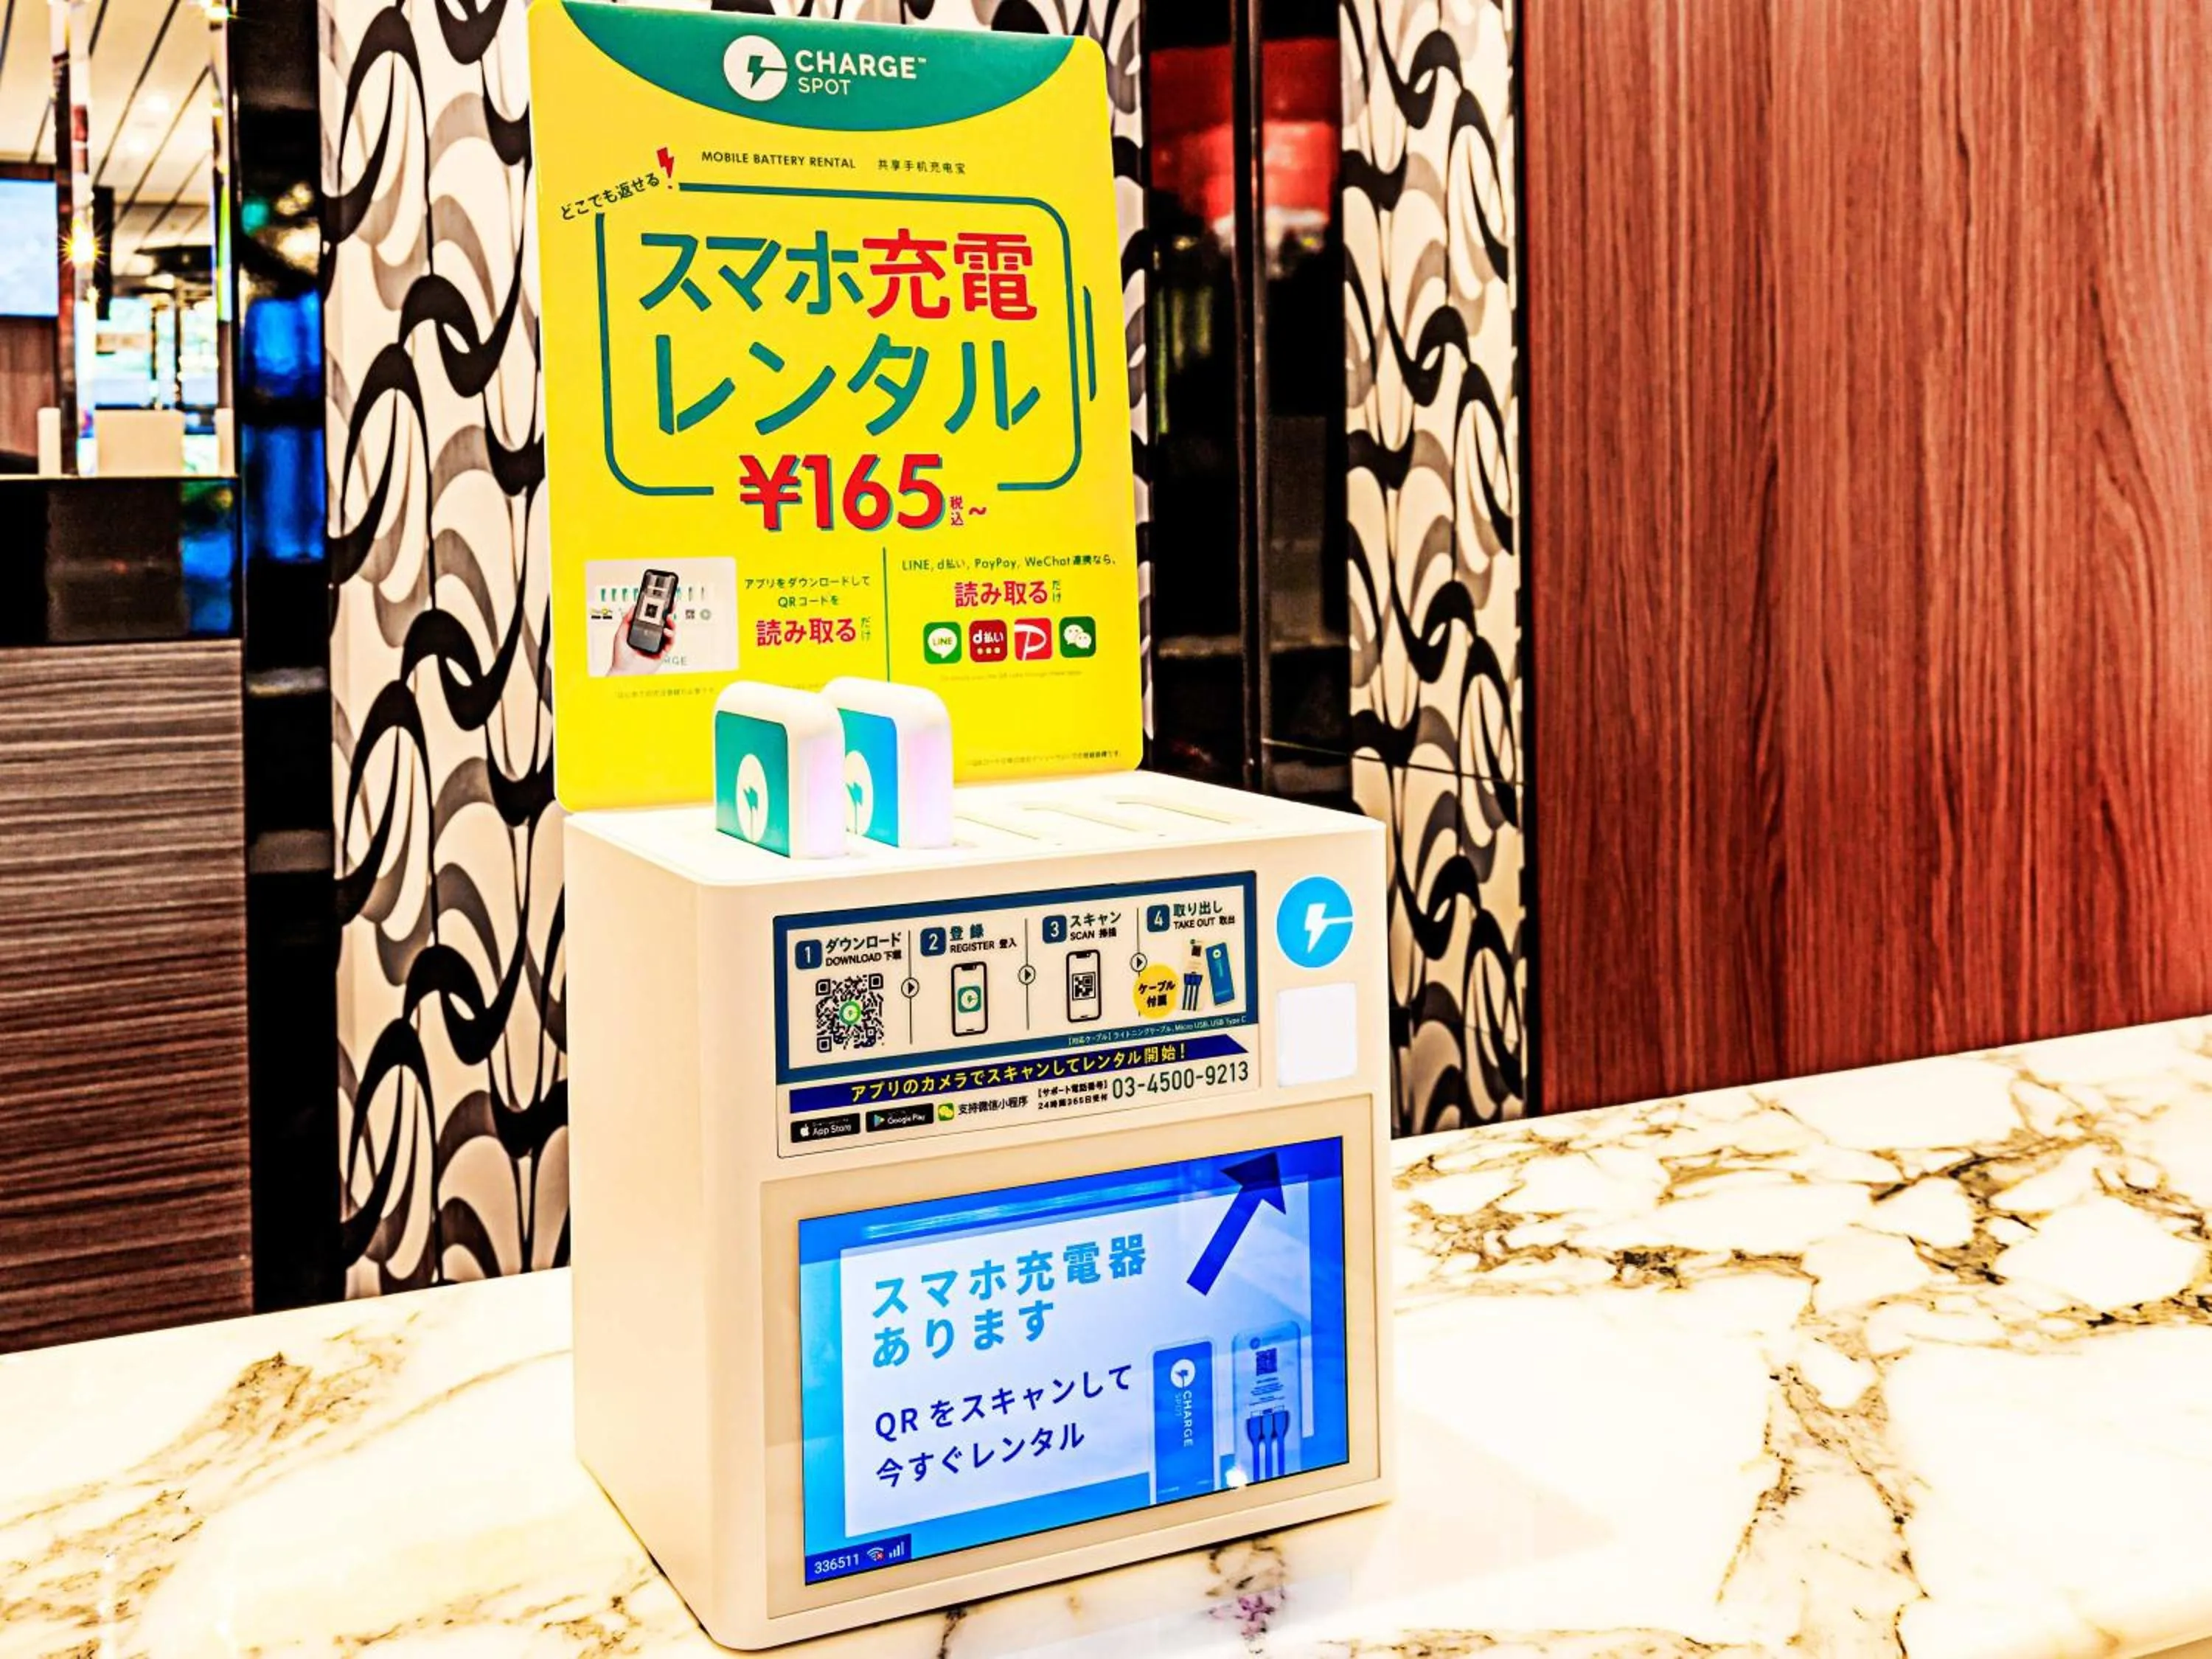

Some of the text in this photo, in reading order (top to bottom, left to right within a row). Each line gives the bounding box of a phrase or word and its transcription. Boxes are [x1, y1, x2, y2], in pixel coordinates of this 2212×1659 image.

[798, 77, 851, 95] SPOT
[701, 151, 856, 170] MOBILE BATTERY RENTAL
[639, 227, 1037, 321] スマホ充電
[655, 333, 1041, 437] レンタル
[739, 453, 947, 532] ¥165
[744, 574, 871, 590] アプリをダウンロードして
[953, 580, 1048, 608] 読み取る
[755, 617, 857, 647] 読み取る
[933, 636, 953, 647] LINE
[1050, 911, 1121, 938] 3 スキャン
[1153, 900, 1223, 927] 4 取り出し
[1173, 917, 1215, 930] TAKE OUT
[804, 931, 902, 964] 1 ダウンロード
[928, 933, 939, 951] 2
[950, 940, 995, 953] REGISTER
[1070, 930, 1095, 942] SCAN
[825, 951, 882, 967] DOWNLOAD
[1138, 979, 1176, 995] ケーブル
[1112, 1061, 1249, 1099] 03-4500-9213
[813, 1127, 830, 1136] App
[872, 1233, 1147, 1319] スマホ充電器
[872, 1299, 1054, 1369] あります
[1183, 1389, 1194, 1448] CHARGE
[875, 1422, 1085, 1488] 今すぐレンタル
[813, 1553, 860, 1575] 336511
